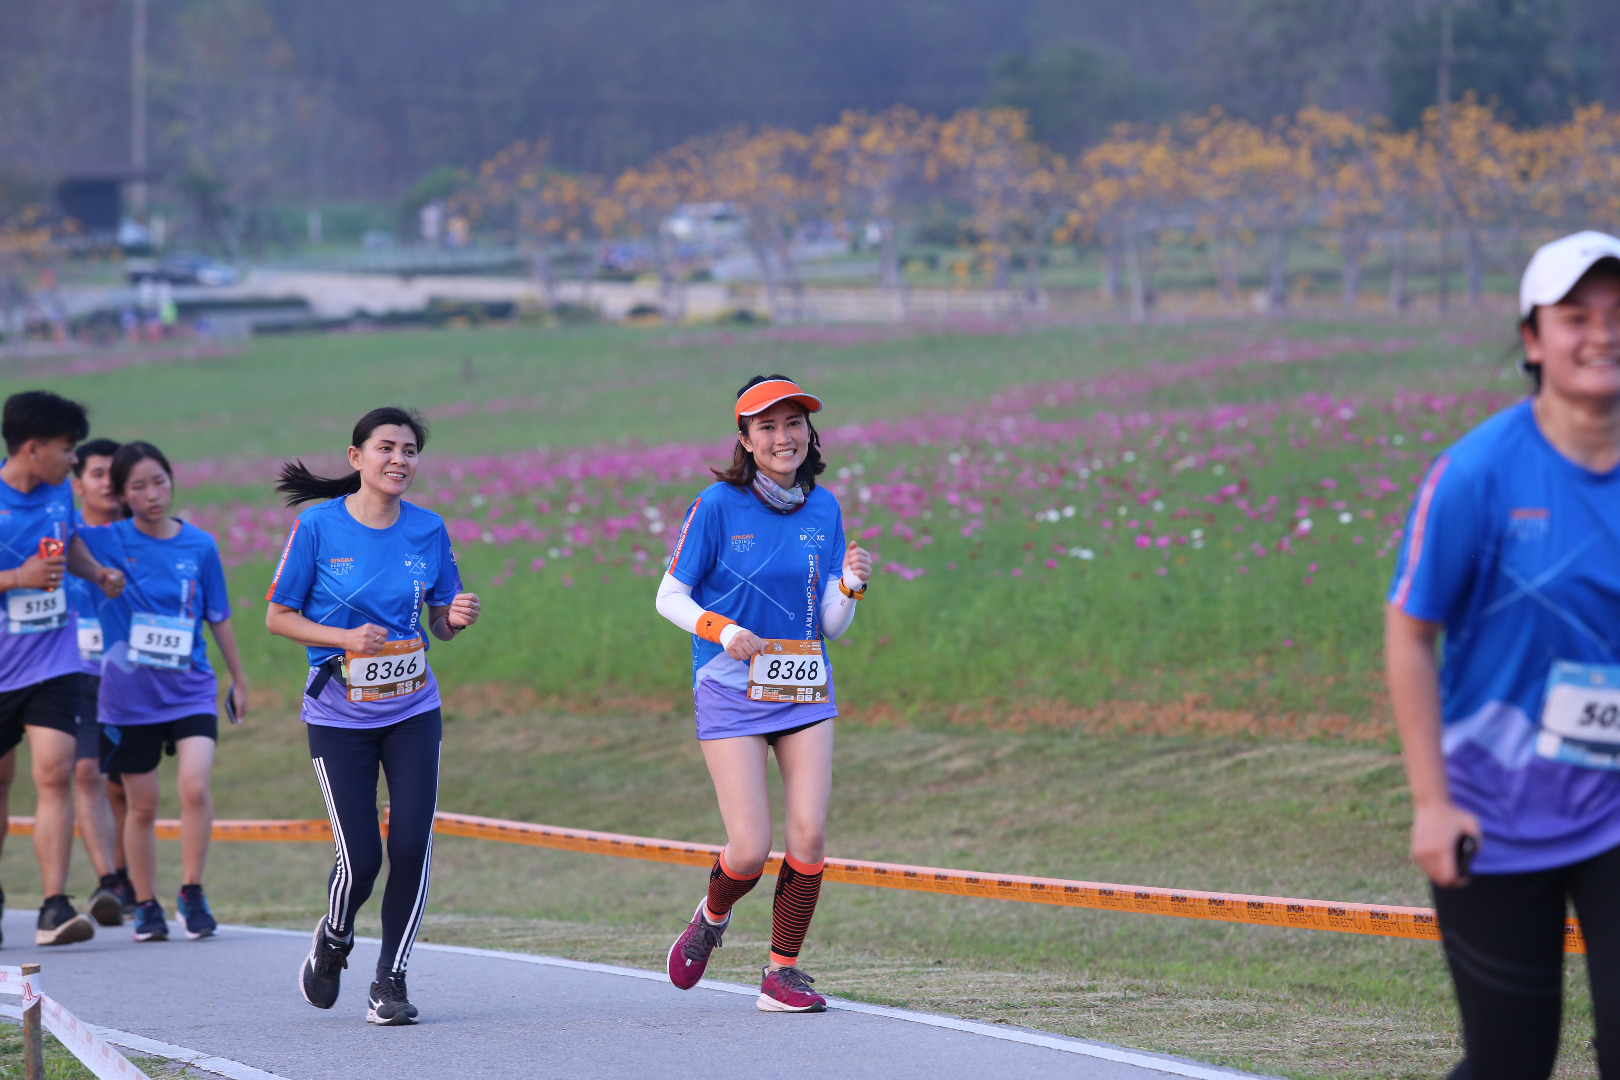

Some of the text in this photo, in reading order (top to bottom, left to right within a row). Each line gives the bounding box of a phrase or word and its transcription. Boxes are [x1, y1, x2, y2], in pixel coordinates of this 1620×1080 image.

[805, 586, 813, 628] COUNTRY
[145, 632, 181, 648] 5153
[365, 656, 418, 681] 8366
[766, 659, 819, 681] 8368
[415, 681, 421, 690] 8
[754, 688, 761, 698] F
[815, 692, 821, 701] 8
